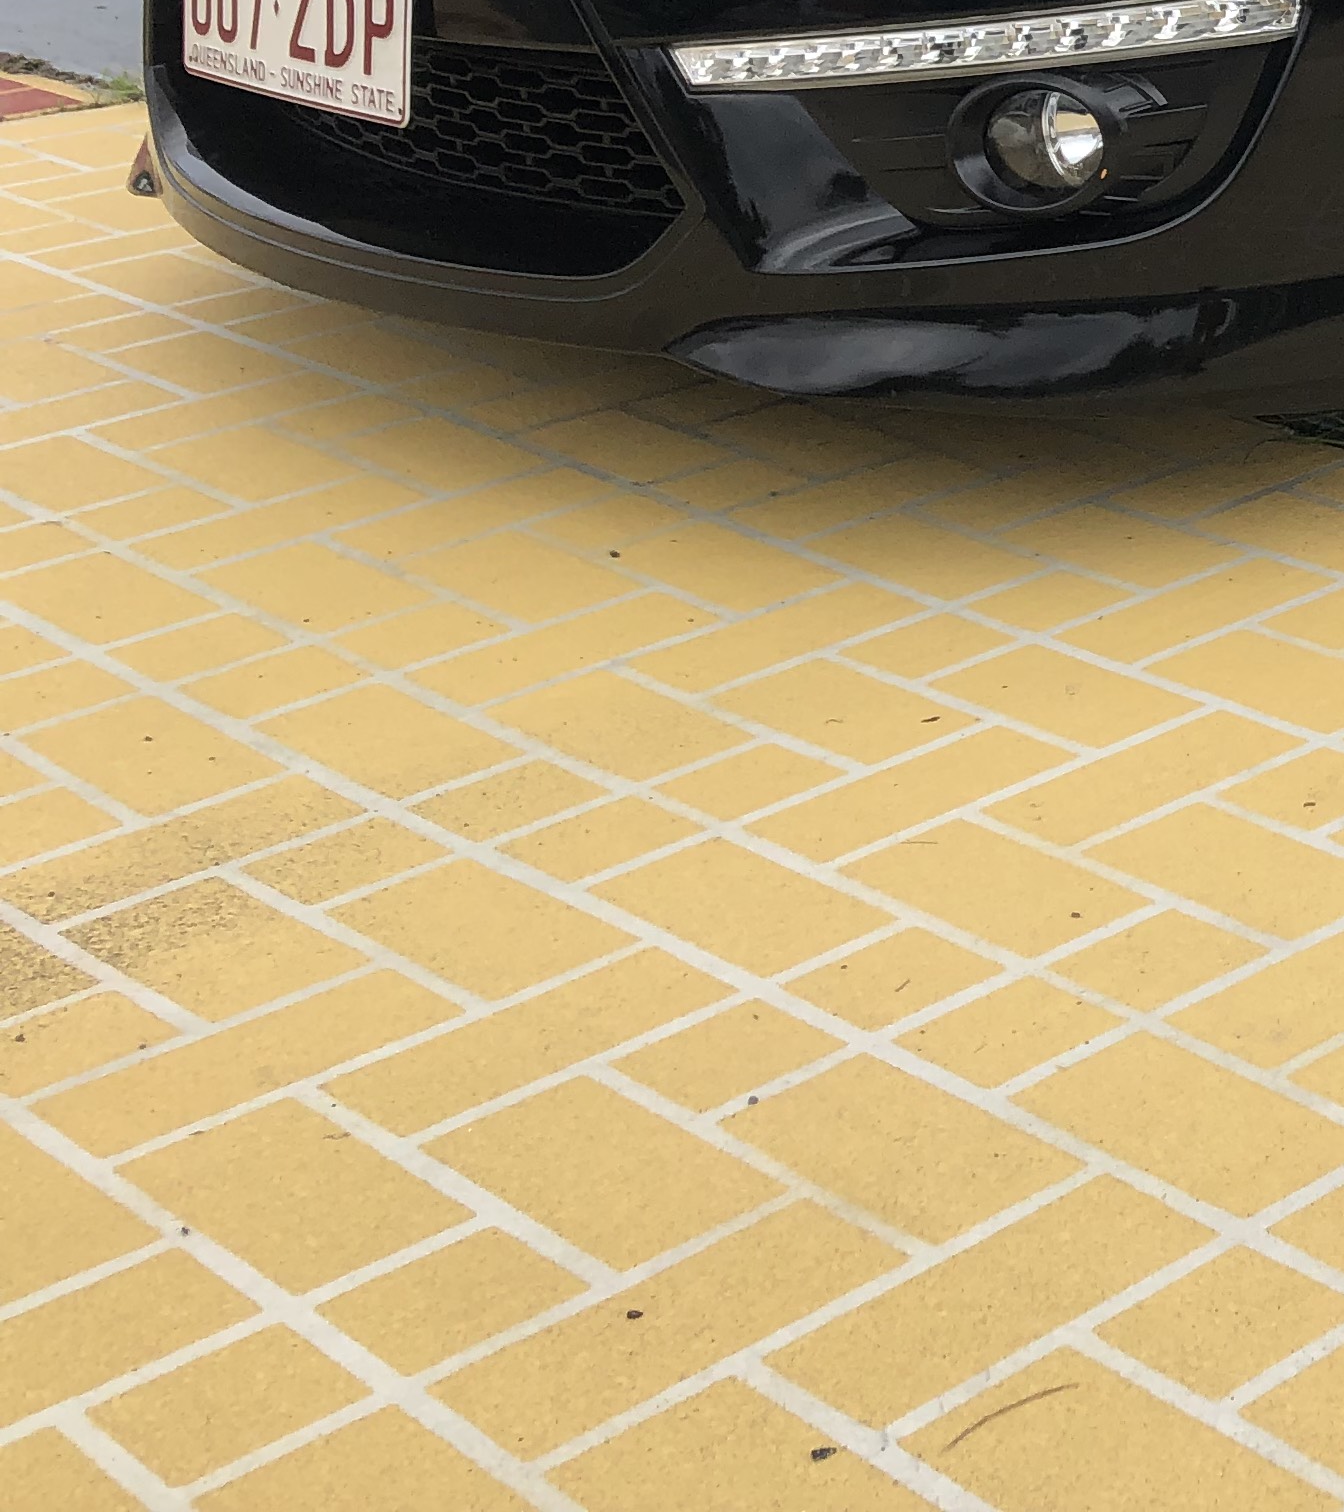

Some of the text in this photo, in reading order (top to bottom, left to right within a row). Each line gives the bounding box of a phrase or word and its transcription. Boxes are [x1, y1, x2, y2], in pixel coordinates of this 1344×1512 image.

[190, 43, 266, 82] QUEENSLAND
[280, 66, 343, 102] SUNSHINE
[351, 83, 395, 112] STATE
